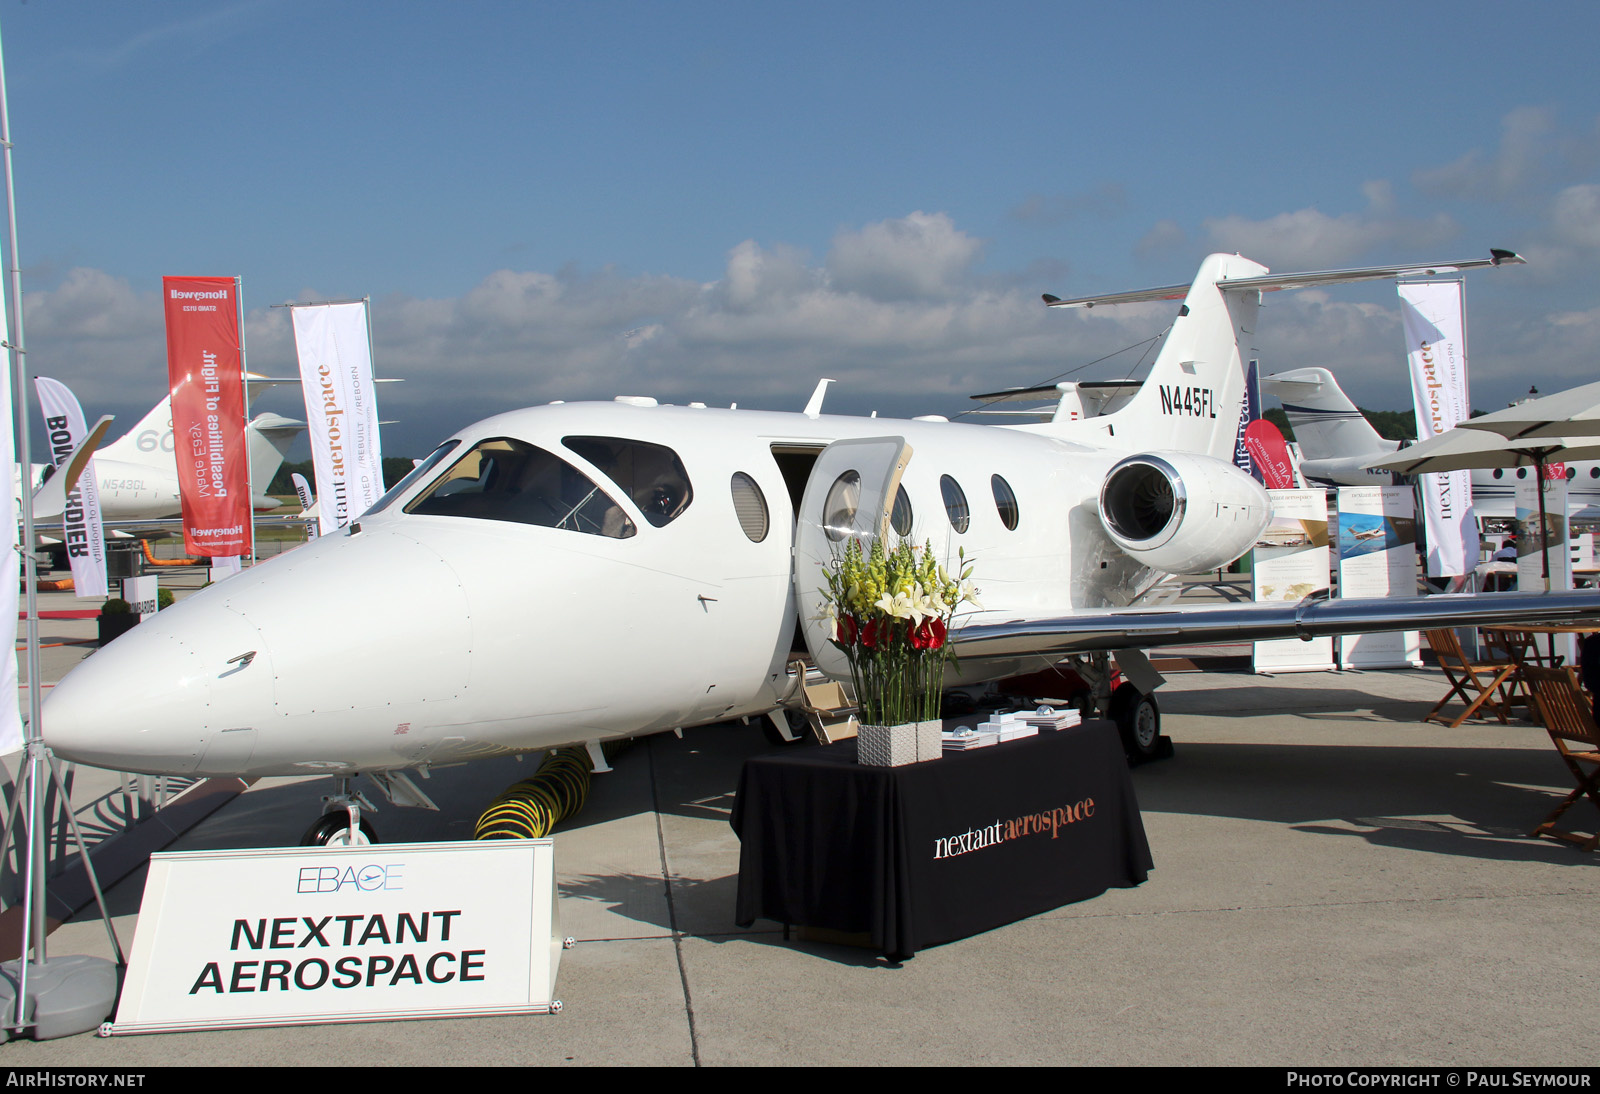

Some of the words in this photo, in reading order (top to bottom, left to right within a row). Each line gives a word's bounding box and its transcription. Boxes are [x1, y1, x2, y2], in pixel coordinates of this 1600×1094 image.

[1159, 385, 1216, 418] N445FL
[1420, 340, 1444, 434] erospace
[318, 364, 344, 477] aerospace
[332, 479, 349, 529] xtant
[364, 475, 373, 508] GINED
[1436, 471, 1452, 521] nexta
[297, 863, 406, 894] EBACE
[230, 910, 462, 951] NEXTANT
[189, 949, 486, 995] AEROSPACE
